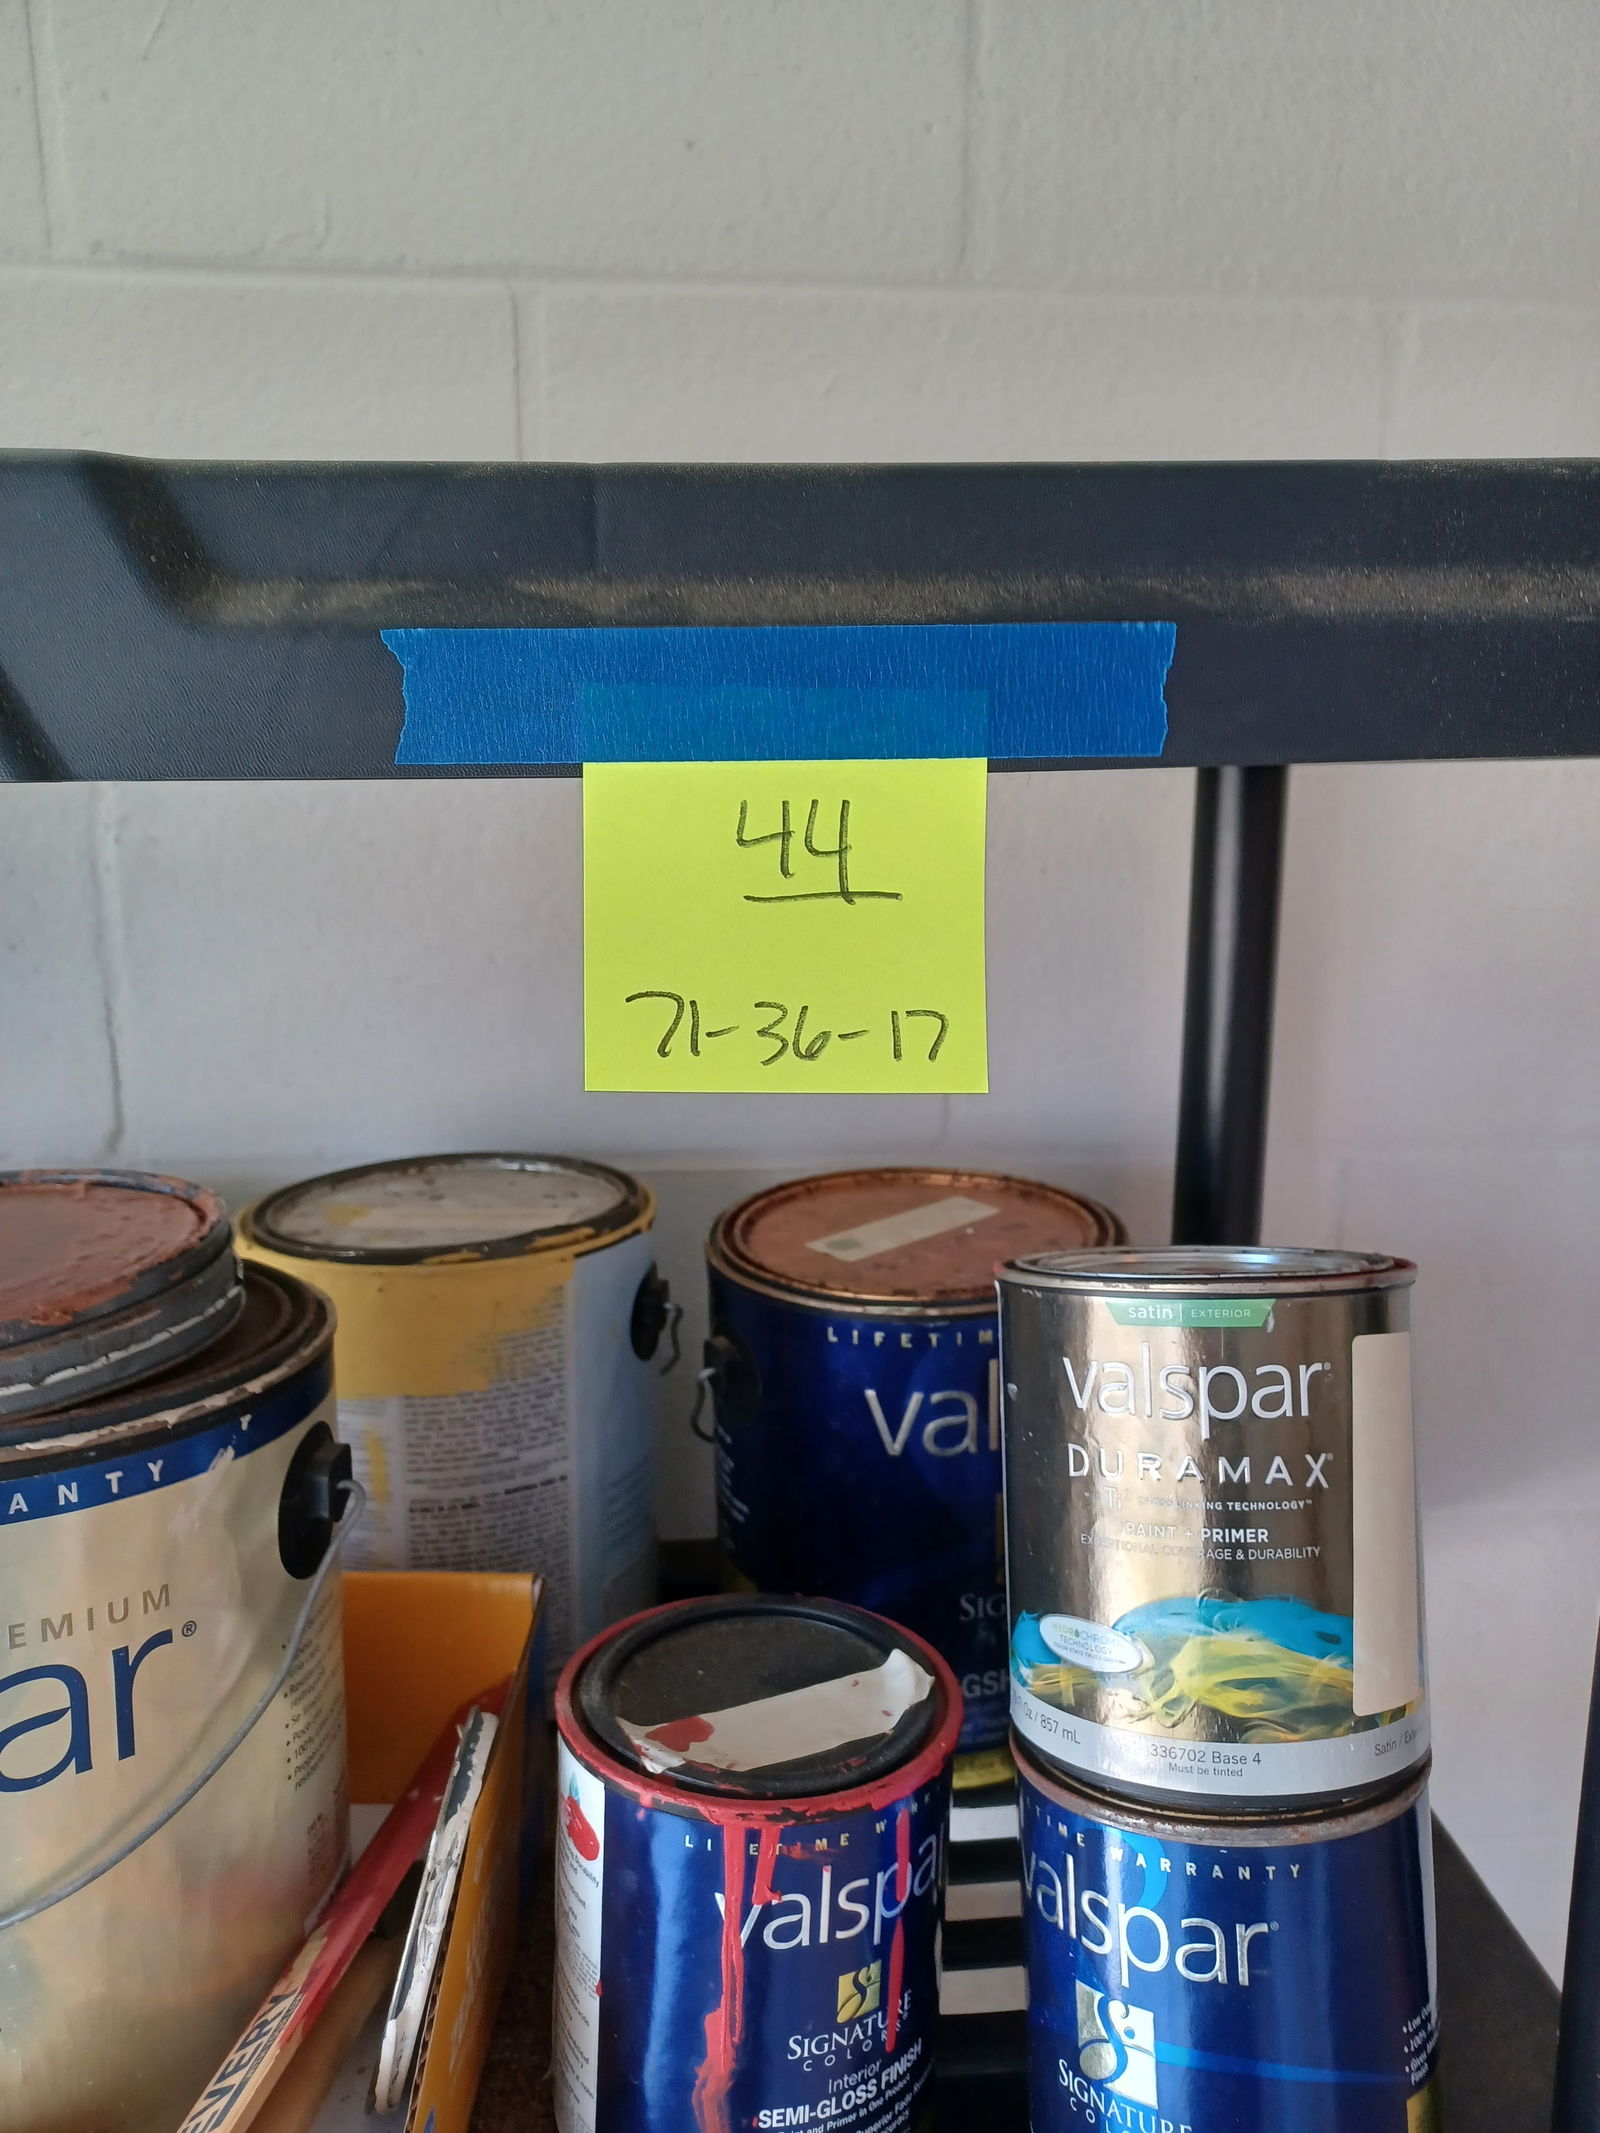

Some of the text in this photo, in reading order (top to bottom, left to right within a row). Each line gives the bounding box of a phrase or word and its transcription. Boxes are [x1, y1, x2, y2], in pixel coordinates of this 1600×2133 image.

[736, 799, 855, 905] 44
[625, 989, 950, 1066] 71-36-17
[1128, 1304, 1252, 1320] satin EXTERIOR
[1125, 1520, 1177, 1540] PAINT
[1201, 1528, 1270, 1544] PRIMER
[1080, 1533, 1321, 1561] EXTIONAL CORAGE & DURABILITY
[1040, 1713, 1059, 1734] 857
[1062, 1728, 1081, 1745] mL
[1150, 1743, 1262, 1765] 336702 Base 4
[1168, 1761, 1243, 1777] Must be tinted
[684, 1832, 850, 1857] LIETME
[1109, 1845, 1301, 1881] WARRANTY
[758, 2078, 878, 2129] SEMI-GLOSS
[880, 2037, 922, 2091] FINISH
[828, 2059, 883, 2095] Interior
[826, 2112, 857, 2131] Primer
